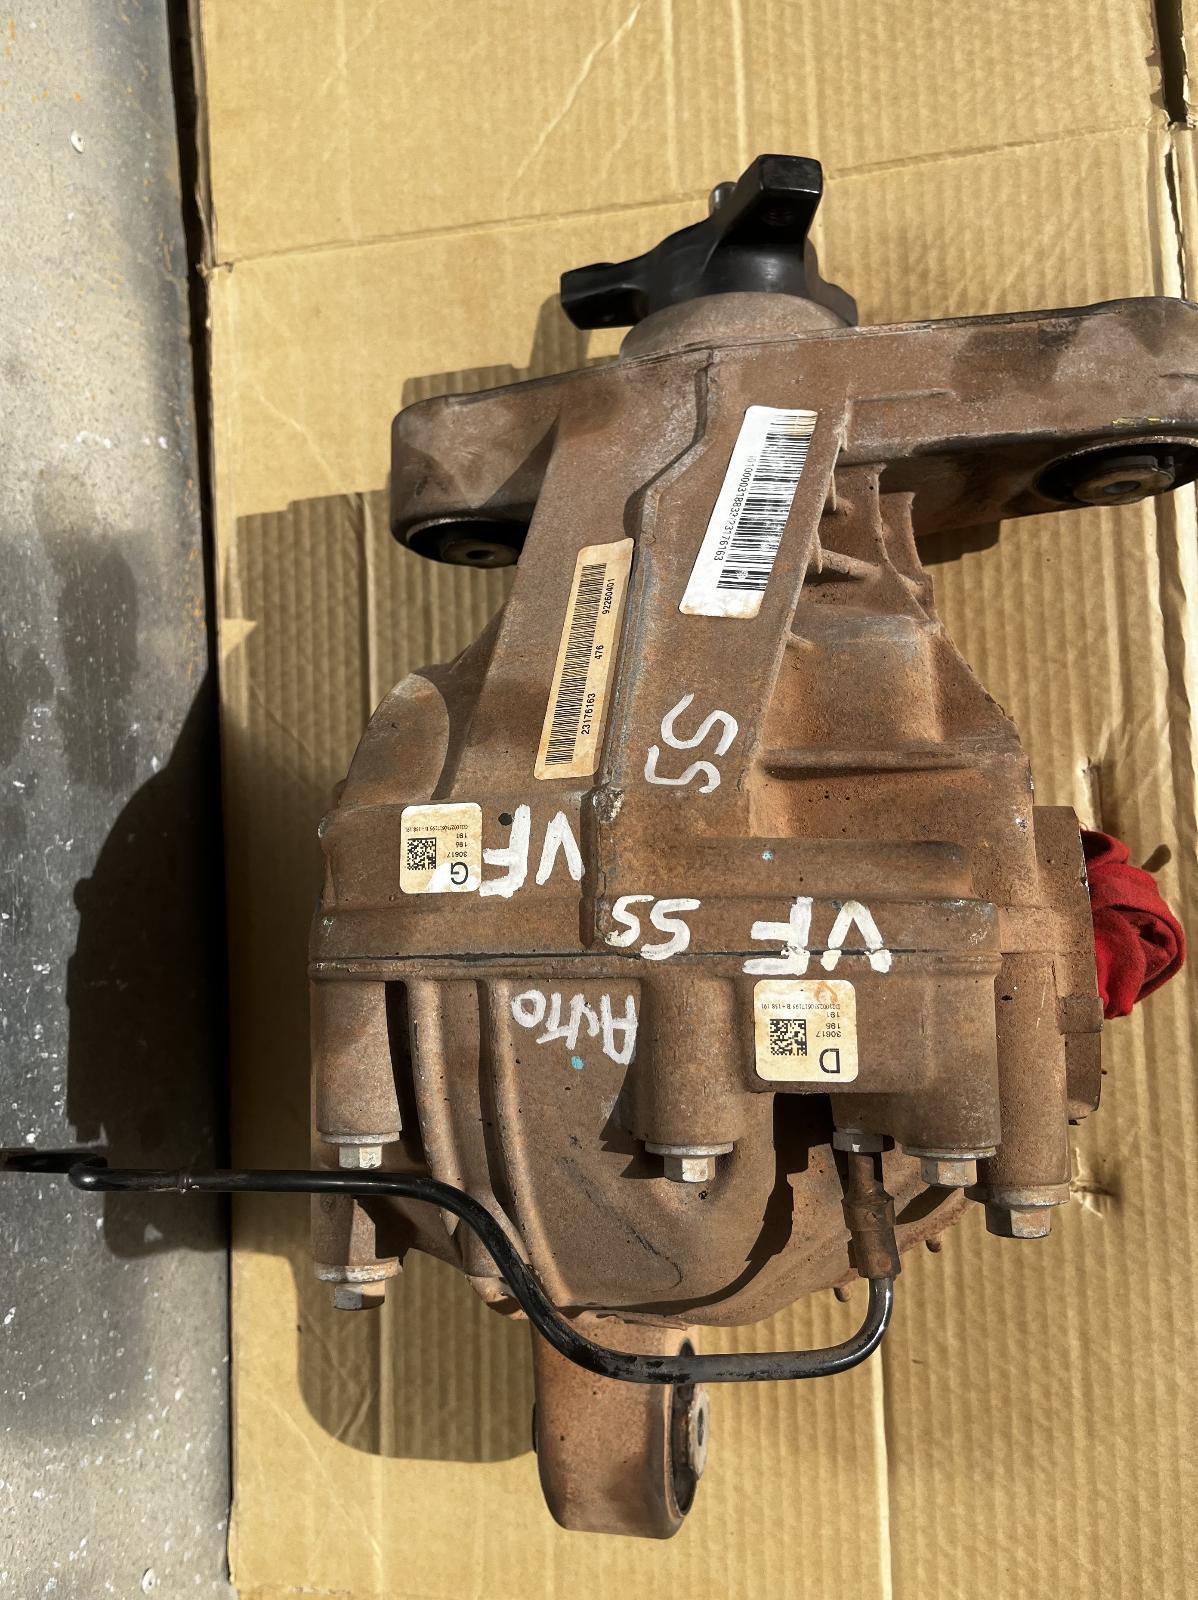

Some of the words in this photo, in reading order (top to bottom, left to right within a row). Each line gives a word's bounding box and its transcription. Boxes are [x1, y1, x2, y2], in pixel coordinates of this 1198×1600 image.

[581, 693, 596, 736] 23176163
[594, 644, 605, 660] 476
[602, 578, 616, 615] 92260401
[644, 692, 739, 794] SS
[451, 861, 469, 885] G
[479, 804, 585, 898] VF
[605, 895, 701, 960] SS
[742, 896, 892, 975] VF
[511, 990, 638, 1065] AUTO
[815, 1030, 842, 1038] 30617
[819, 1048, 840, 1074] D
